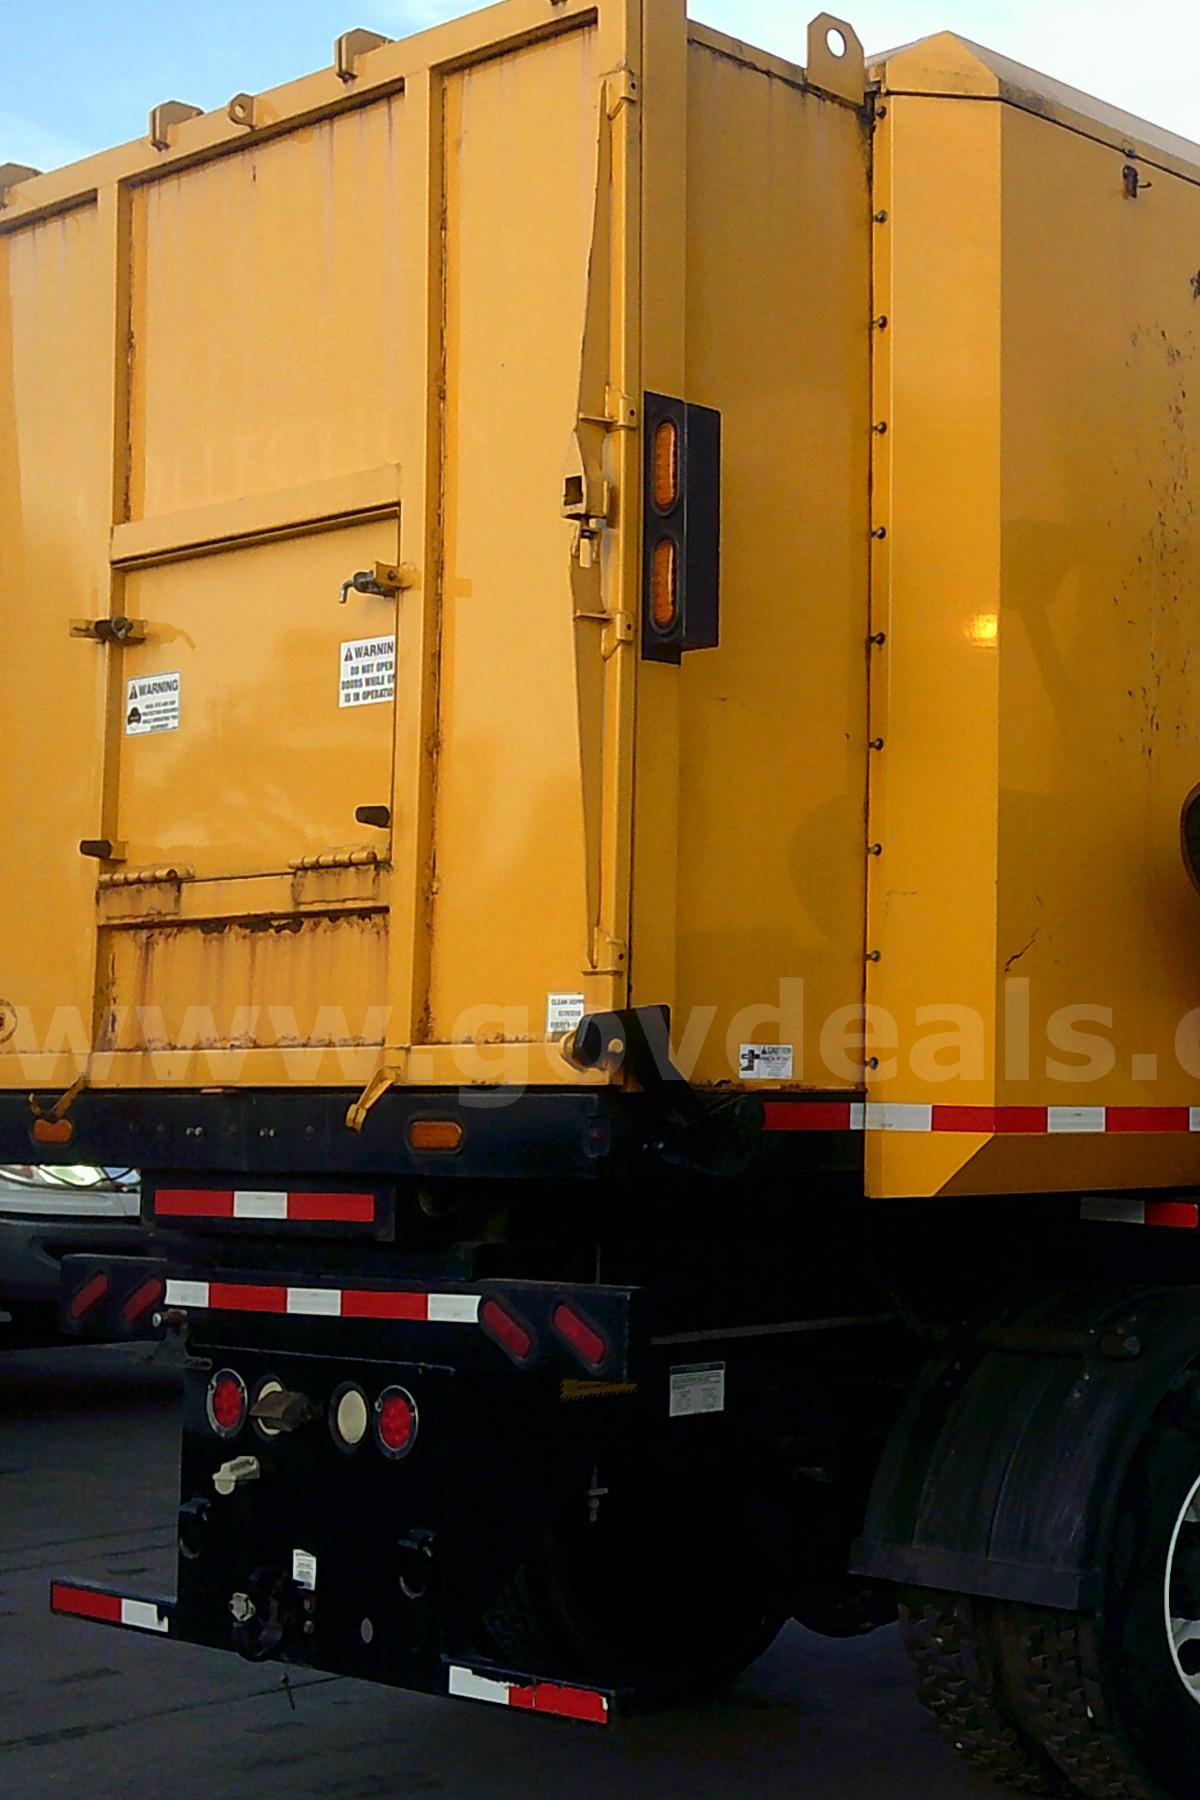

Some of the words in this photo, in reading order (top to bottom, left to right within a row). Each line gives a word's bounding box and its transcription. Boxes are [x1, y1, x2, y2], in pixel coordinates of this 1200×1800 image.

[354, 641, 394, 659] WARNIN
[139, 679, 179, 697] WARNING
[362, 687, 393, 700] OPERATIO
